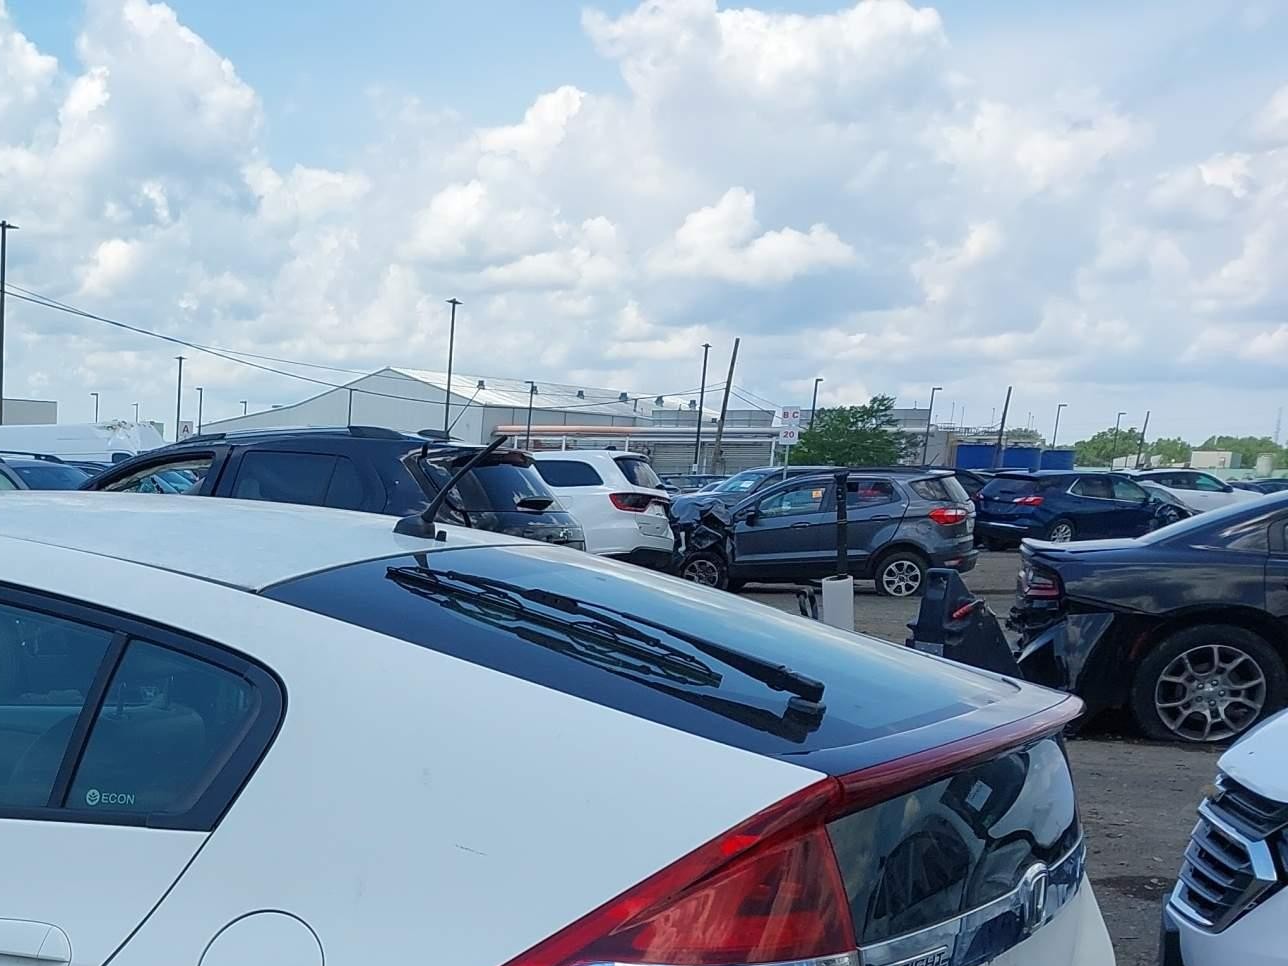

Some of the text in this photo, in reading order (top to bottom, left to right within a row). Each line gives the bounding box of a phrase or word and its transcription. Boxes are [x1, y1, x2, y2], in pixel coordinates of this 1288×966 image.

[783, 411, 799, 419] B C
[182, 424, 189, 433] A
[783, 430, 795, 439] 20
[101, 792, 135, 805] ECON
